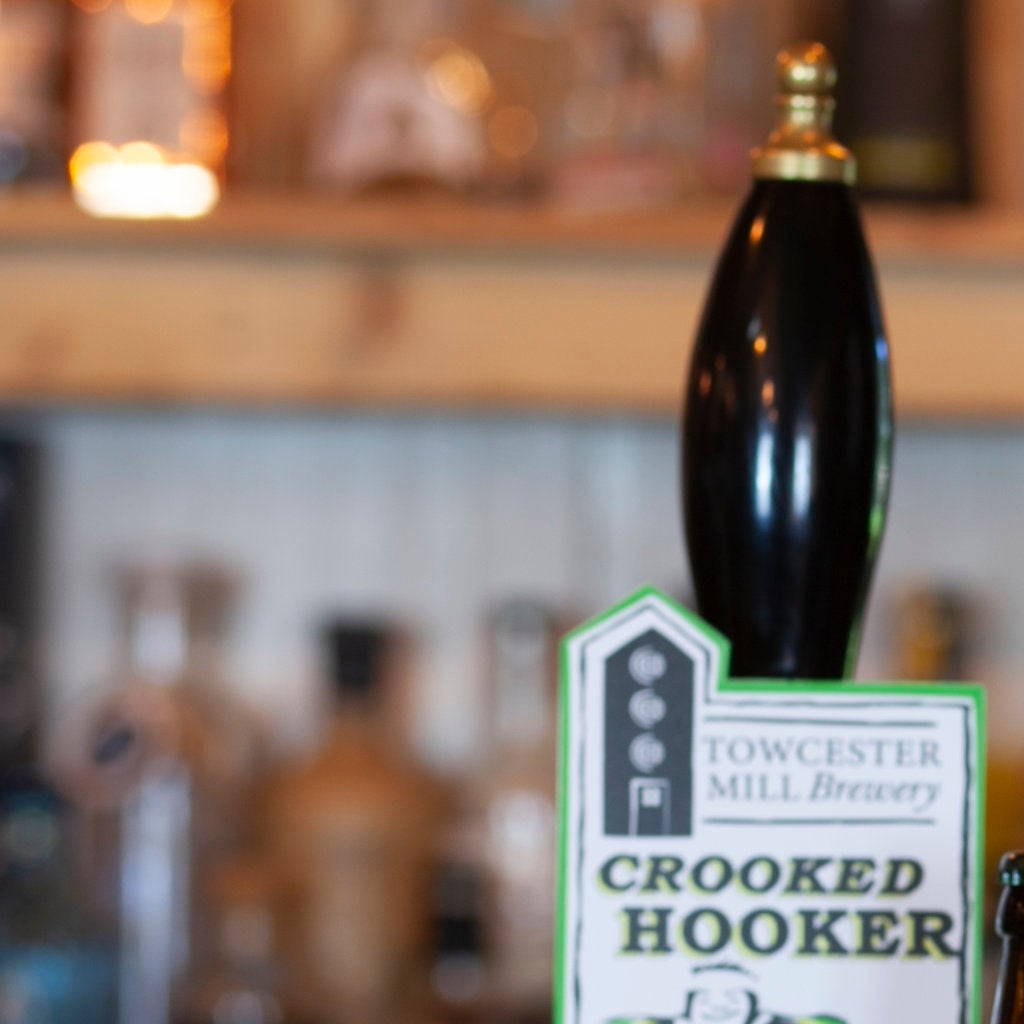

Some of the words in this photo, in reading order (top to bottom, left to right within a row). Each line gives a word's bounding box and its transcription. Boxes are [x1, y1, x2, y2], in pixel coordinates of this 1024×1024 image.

[704, 737, 941, 766] TOWCESTER
[709, 773, 799, 801] MILL
[810, 772, 941, 814] Brewery
[598, 855, 924, 896] CROOKED
[617, 907, 962, 957] HOOKER
